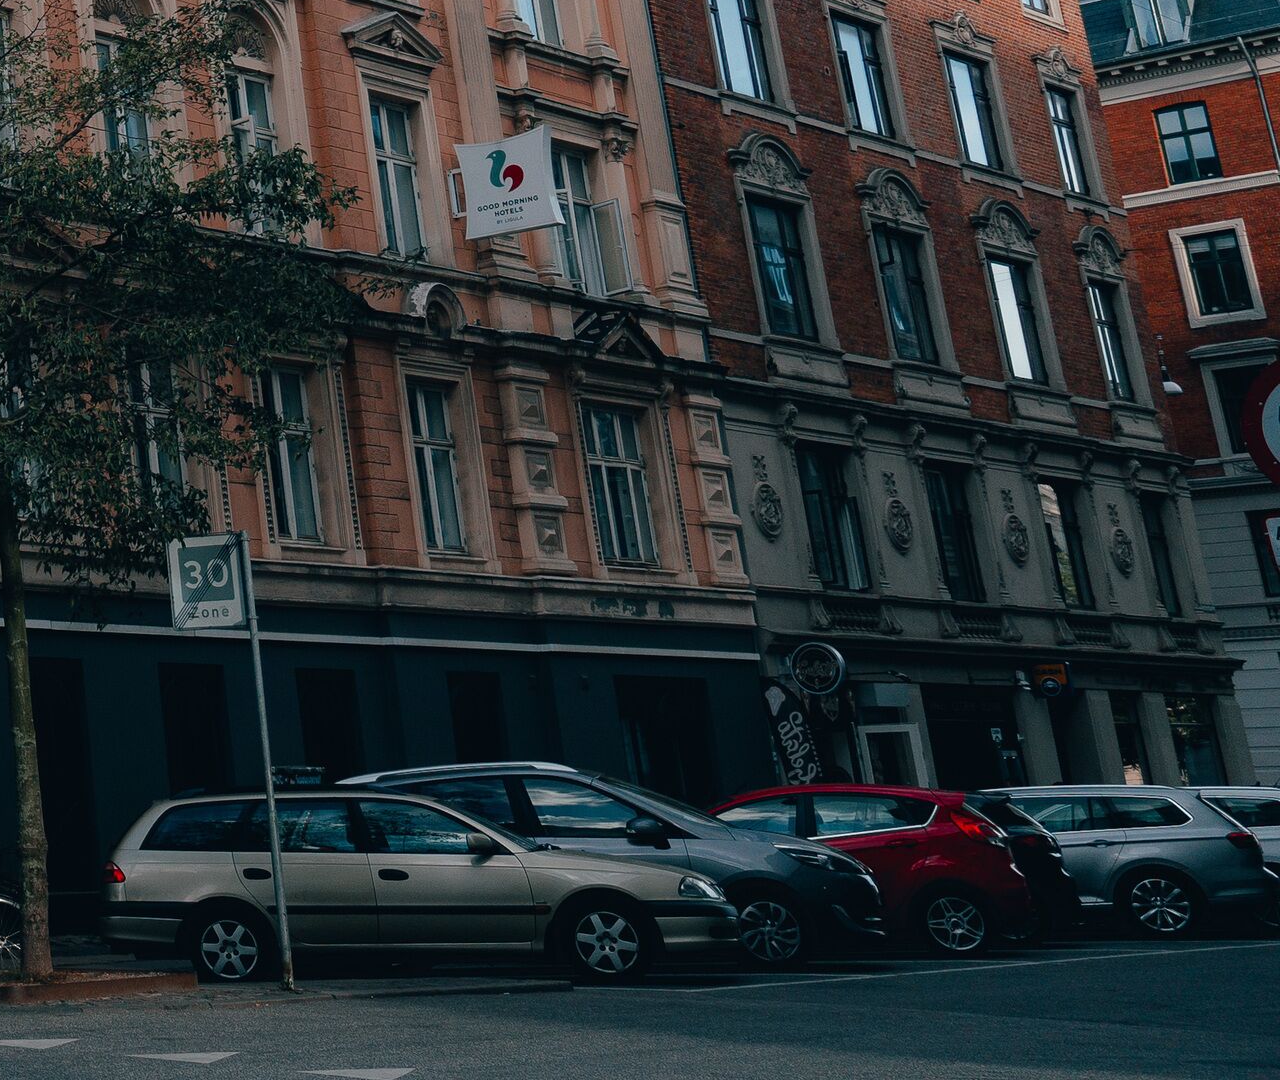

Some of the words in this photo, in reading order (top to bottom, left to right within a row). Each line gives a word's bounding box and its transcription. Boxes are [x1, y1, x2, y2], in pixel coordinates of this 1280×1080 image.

[477, 203, 500, 212] GOOD
[502, 195, 539, 207] MORNING
[494, 206, 524, 217] HOTELS
[183, 558, 229, 590] 30
[189, 607, 230, 619] Zone
